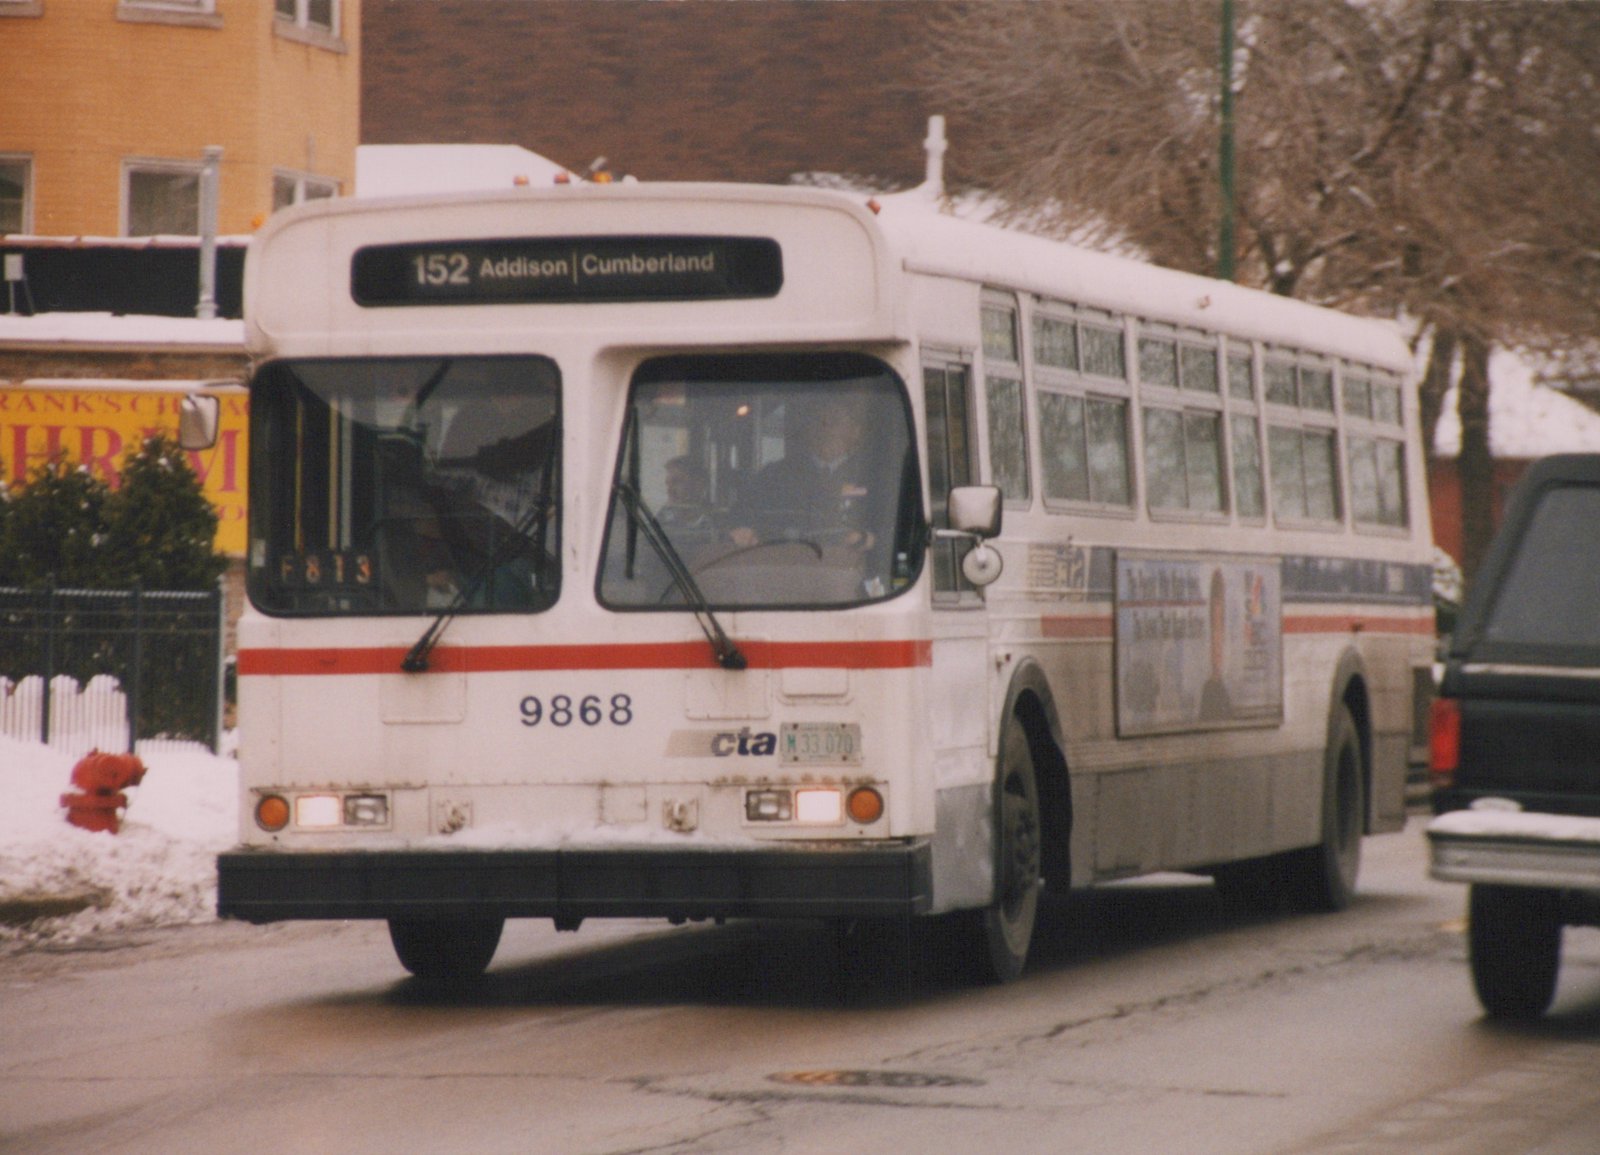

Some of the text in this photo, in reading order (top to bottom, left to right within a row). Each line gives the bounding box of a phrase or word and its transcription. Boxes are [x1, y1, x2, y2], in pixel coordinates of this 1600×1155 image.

[413, 251, 715, 285] 152 Addison Cumberland
[519, 694, 633, 727] 9868
[710, 727, 777, 757] cta
